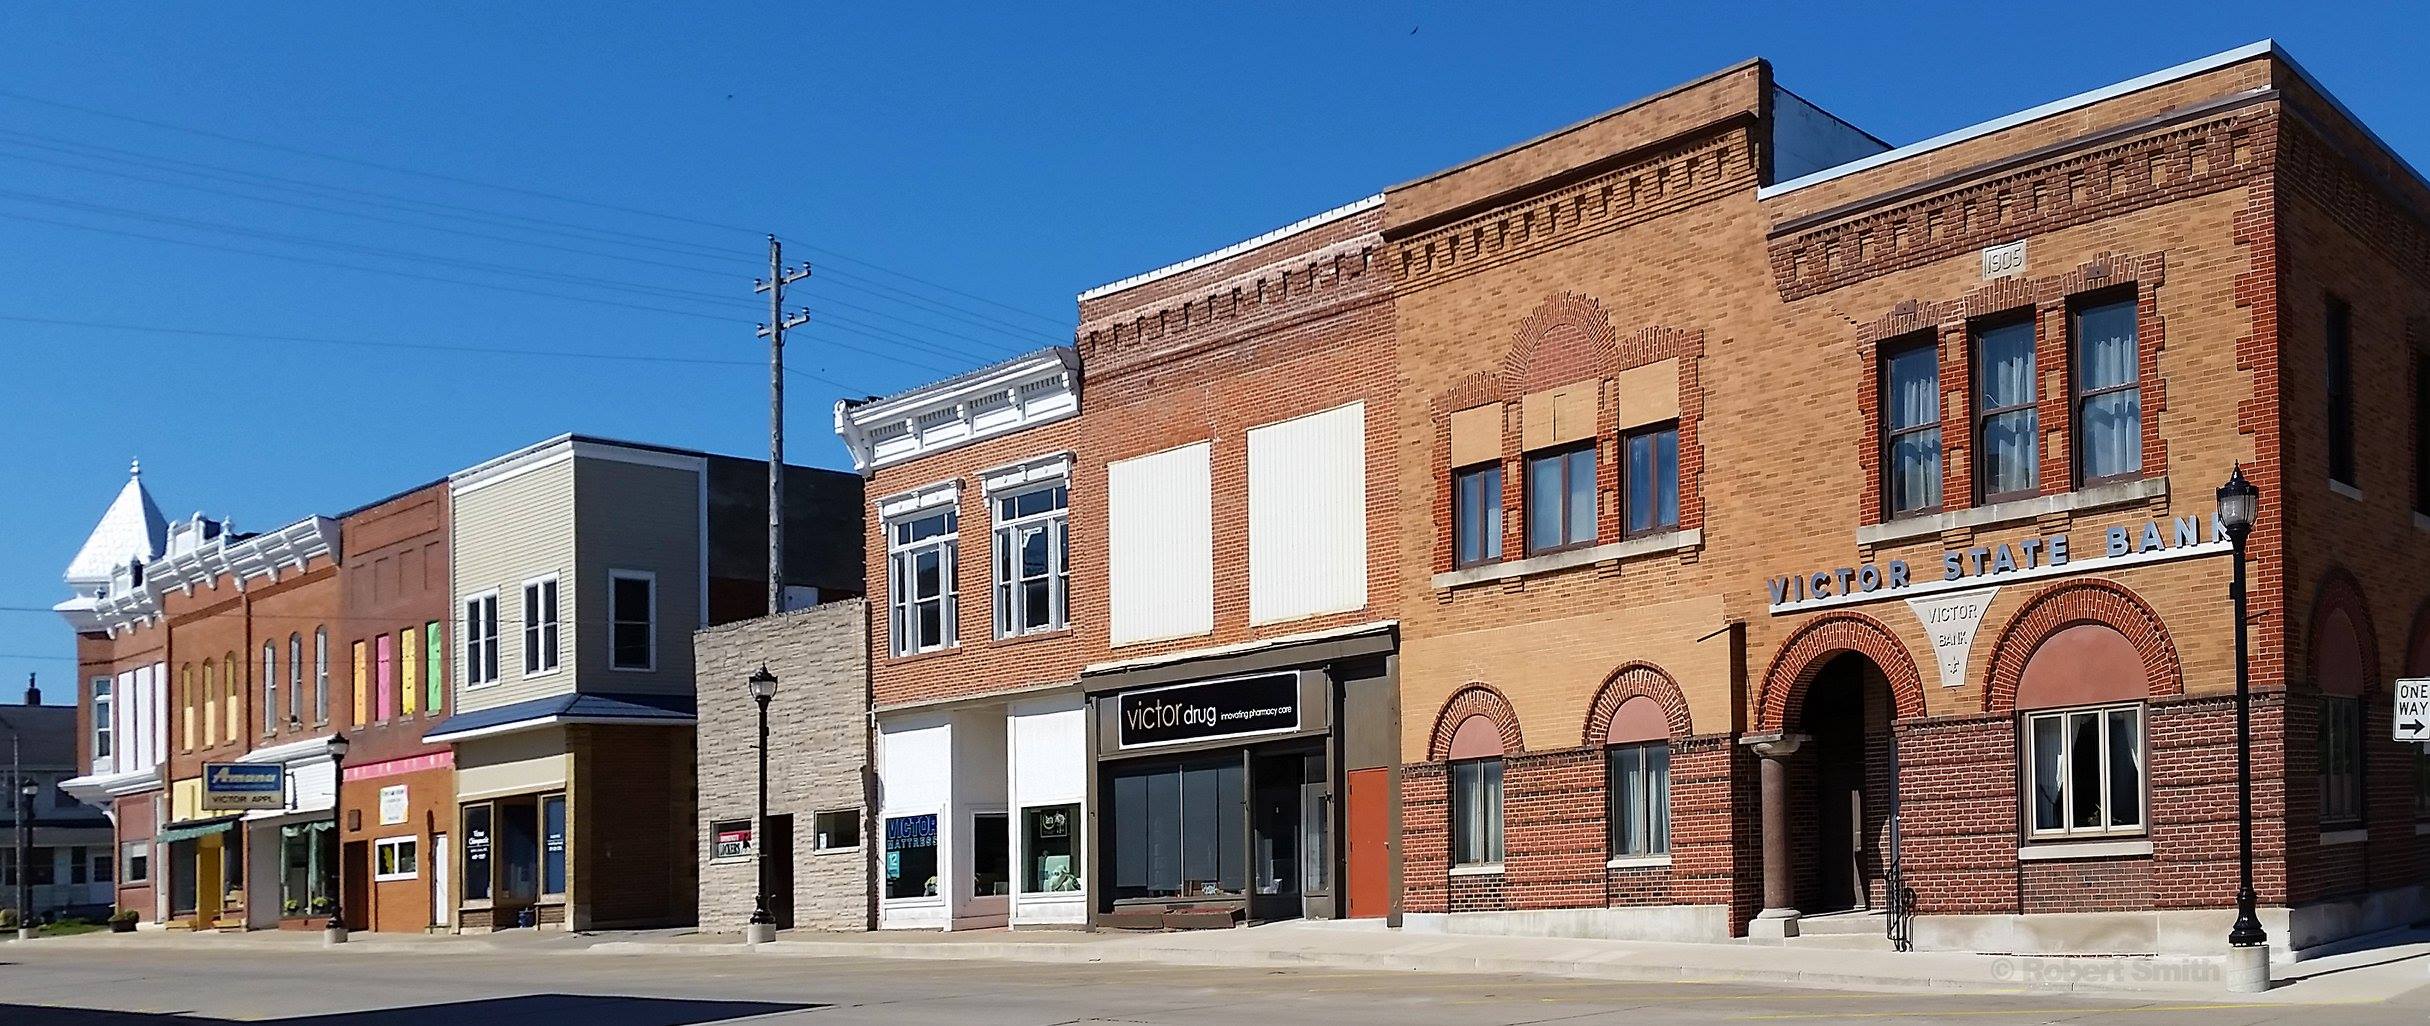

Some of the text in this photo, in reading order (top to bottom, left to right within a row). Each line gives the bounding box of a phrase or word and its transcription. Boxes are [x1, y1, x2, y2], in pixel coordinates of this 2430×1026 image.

[1987, 247, 2023, 274] 1905
[1767, 510, 2233, 605] VICTOR STATE BANK
[1929, 604, 1978, 623] VICTOR
[1939, 631, 1967, 647] BANK
[2400, 684, 2429, 699] ONE
[1127, 699, 1182, 731] victor
[1184, 705, 1217, 727] drug
[1278, 705, 1292, 714] care
[2399, 701, 2429, 716] WAY
[212, 795, 247, 803] VICTOR
[887, 815, 938, 839] VICTOR
[887, 835, 938, 850] MATTRESS
